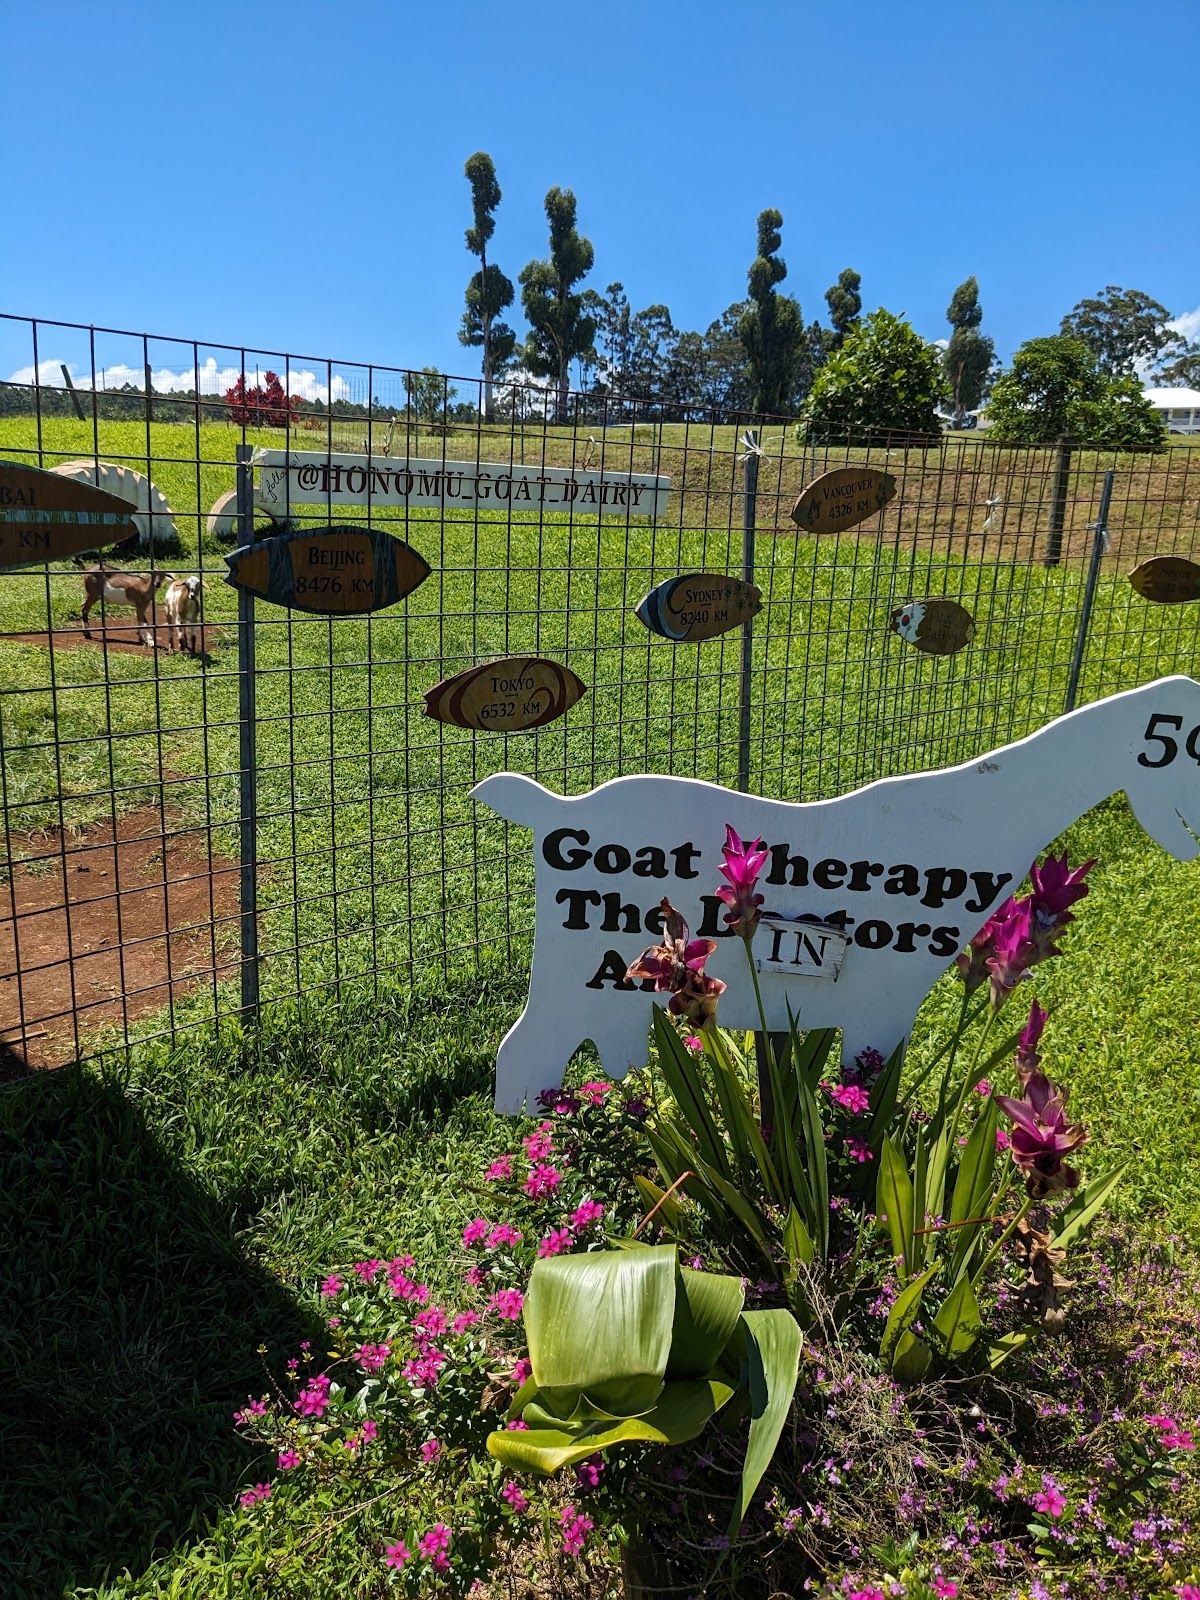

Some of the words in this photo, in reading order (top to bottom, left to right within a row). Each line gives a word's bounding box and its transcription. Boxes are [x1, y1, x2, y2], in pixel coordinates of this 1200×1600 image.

[297, 463, 647, 506] @HONOMU_GOAT_DAIRY
[823, 479, 873, 500] VANCOUVER
[828, 504, 852, 519] 4326
[857, 499, 869, 512] KM
[18, 531, 52, 548] KM
[308, 546, 366, 568] BEIJING
[295, 576, 342, 593] 8476
[351, 579, 375, 593] KM
[685, 589, 724, 603] SYDNEY
[680, 610, 709, 626] 8240
[714, 610, 728, 622] KM
[491, 677, 534, 693] TOKYO
[481, 701, 515, 719] 6532
[522, 701, 542, 715] KM
[542, 827, 702, 880] Goat
[555, 888, 670, 936] The
[766, 928, 832, 966] IN
